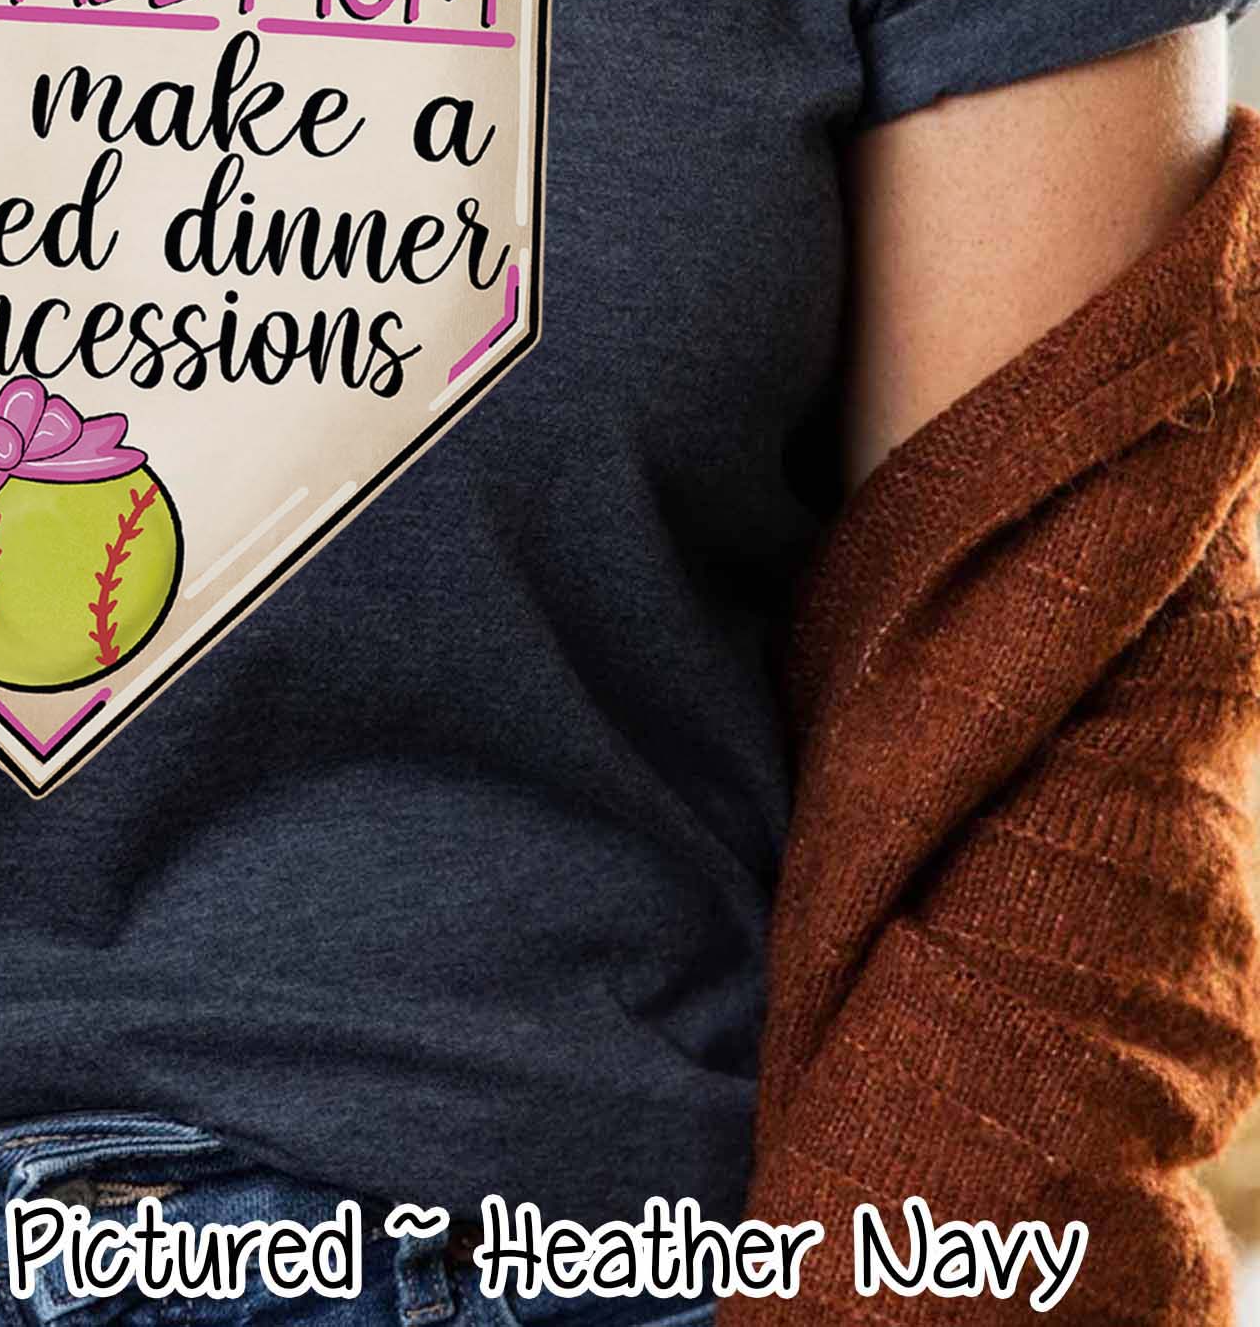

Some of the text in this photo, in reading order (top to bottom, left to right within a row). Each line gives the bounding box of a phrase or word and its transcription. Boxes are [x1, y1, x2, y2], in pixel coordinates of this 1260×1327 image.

[31, 30, 364, 157] make
[412, 95, 495, 166] a
[161, 153, 510, 288] dinner
